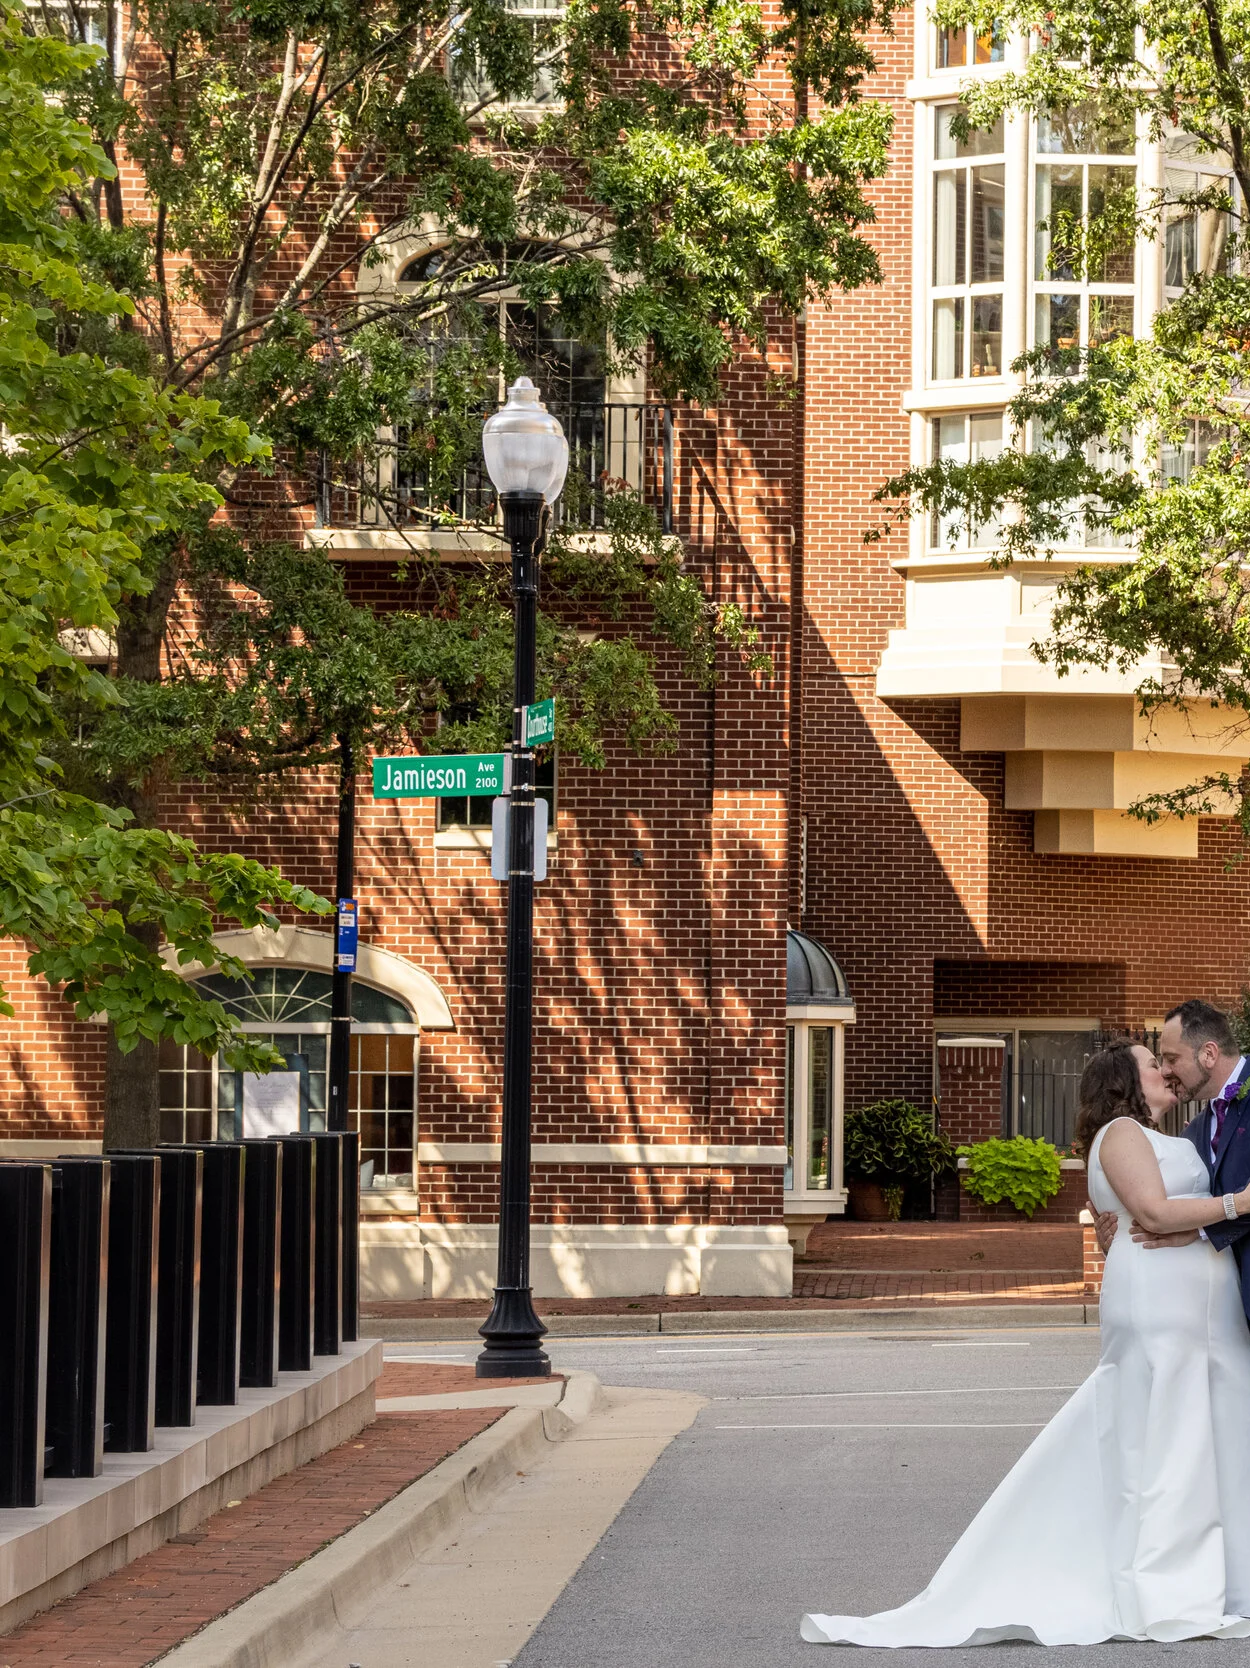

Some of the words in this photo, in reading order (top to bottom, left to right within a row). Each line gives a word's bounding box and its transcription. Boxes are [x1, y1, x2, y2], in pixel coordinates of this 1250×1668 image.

[477, 762, 495, 772] Ave
[381, 763, 467, 791] Jamieson
[475, 777, 498, 788] 2100
